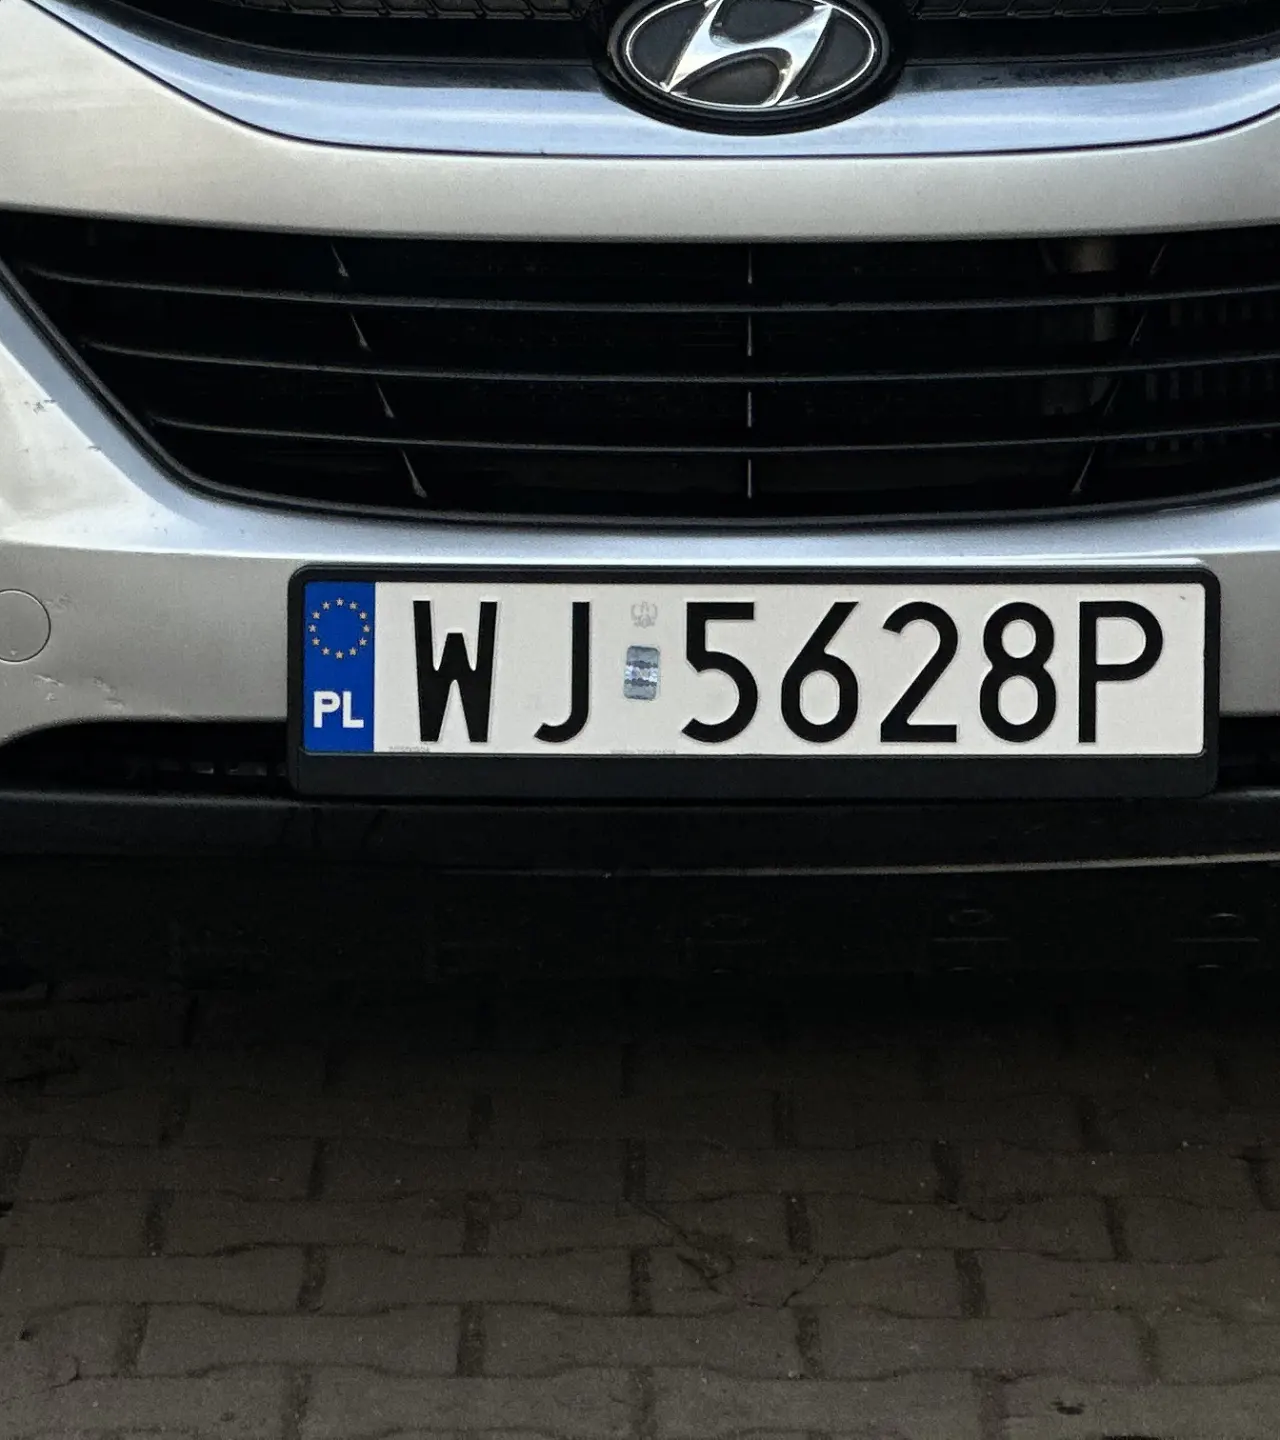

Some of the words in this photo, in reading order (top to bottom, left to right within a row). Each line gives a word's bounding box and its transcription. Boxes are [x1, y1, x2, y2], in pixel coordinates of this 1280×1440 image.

[312, 690, 365, 729] PL
[413, 600, 591, 744] WJ
[681, 600, 1164, 744] 5628P
